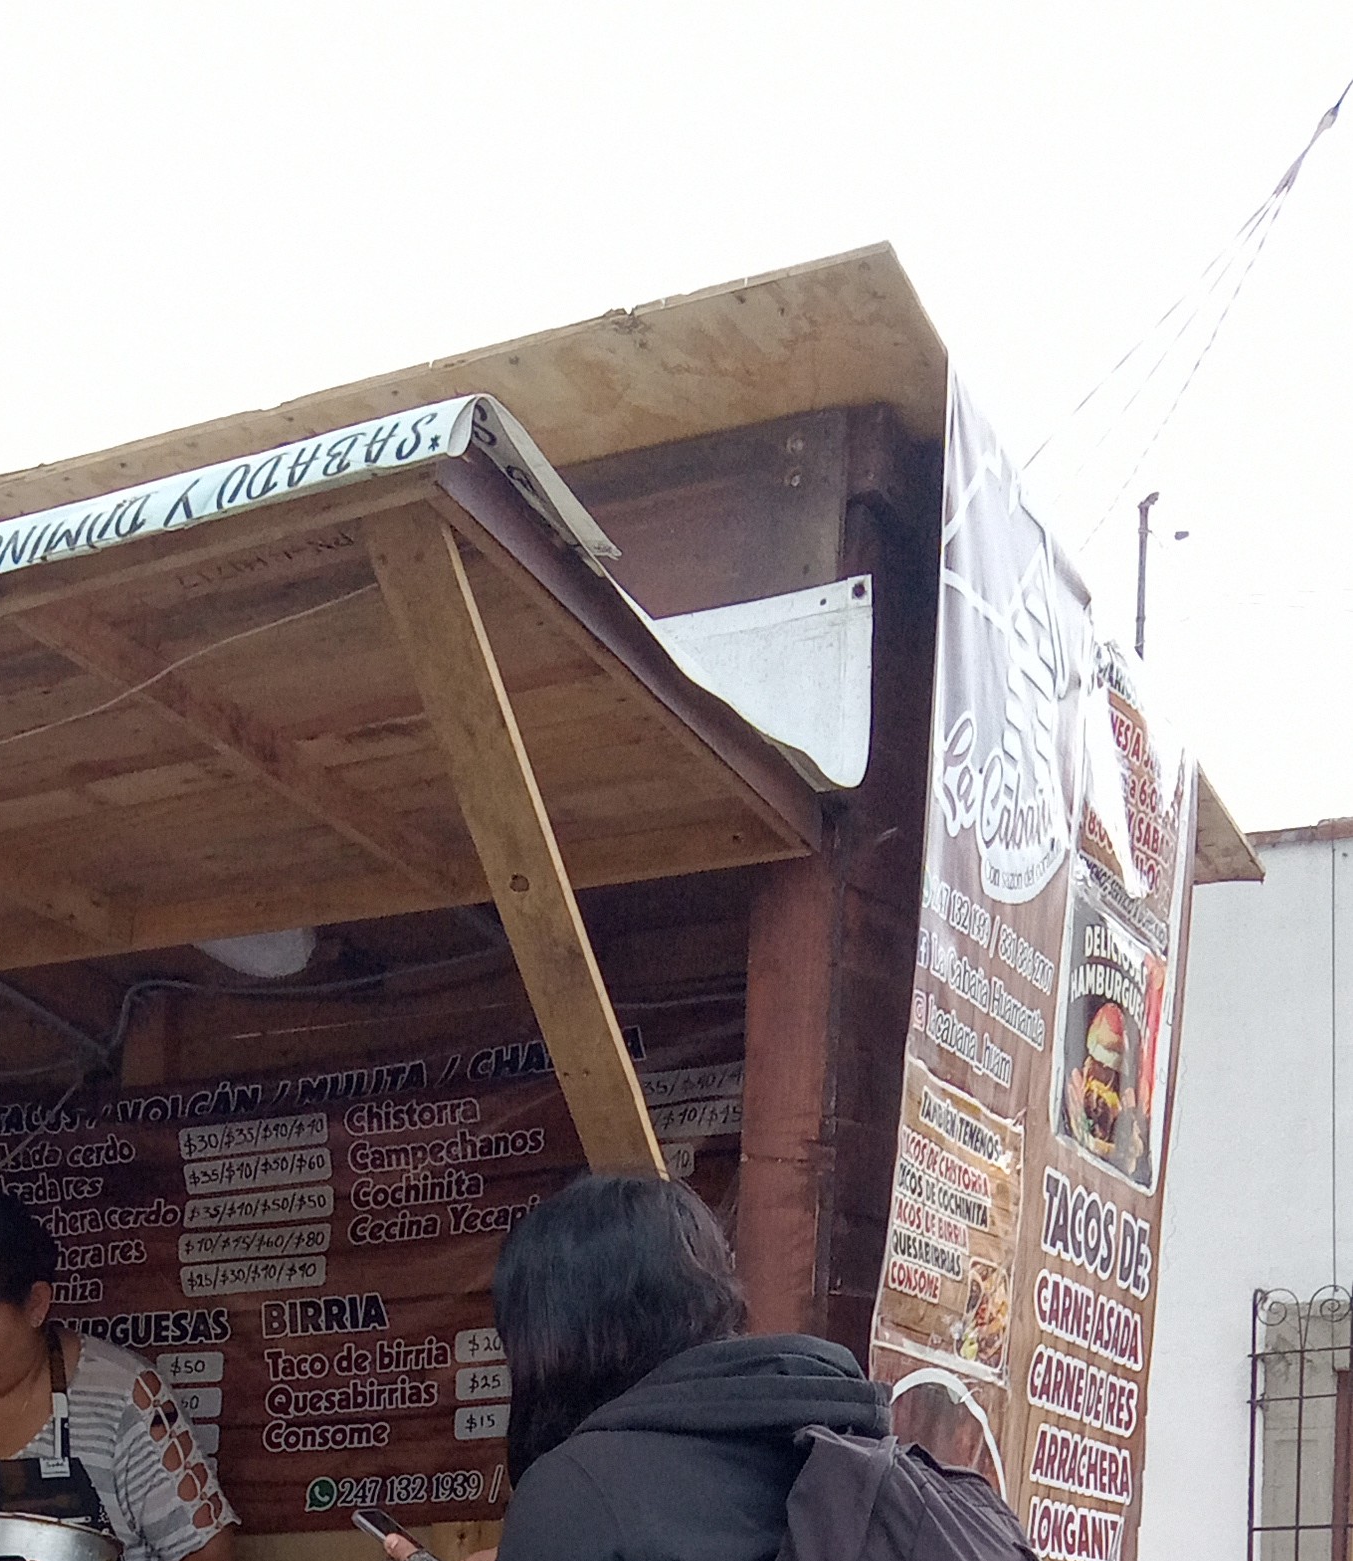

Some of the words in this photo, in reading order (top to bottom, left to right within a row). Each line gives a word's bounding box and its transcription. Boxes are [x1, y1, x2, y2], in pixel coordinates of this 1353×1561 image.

[162, 494, 199, 532] Y
[1070, 963, 1146, 1036] HAMBURGUE
[466, 1026, 645, 1082] CHAA
[344, 1097, 481, 1136] Chistorra
[66, 1133, 137, 1168] cerdo
[347, 1127, 546, 1173] Campechanos
[62, 1175, 104, 1199] res
[350, 1170, 484, 1210] Cochinita
[105, 1198, 182, 1230] cerdo
[348, 1211, 442, 1246] Cecina
[1041, 1165, 1117, 1281] TACOS
[107, 1239, 148, 1265] res
[262, 1291, 391, 1340] BIRRIA
[1034, 1268, 1095, 1349] CARNE
[1092, 1294, 1144, 1372] ASADA
[169, 1355, 206, 1377] $50
[264, 1347, 330, 1382] Taco
[334, 1342, 373, 1376] de
[376, 1335, 452, 1374] birria
[264, 1374, 439, 1418] Quesabirrias
[468, 1374, 502, 1394] $25
[1027, 1343, 1088, 1420] CARNE
[1083, 1365, 1108, 1429] DE
[1103, 1375, 1139, 1438] RES
[262, 1419, 392, 1453] Consome
[465, 1413, 496, 1434] $15
[1030, 1422, 1132, 1505] ARRACHERA
[337, 1477, 381, 1507] 247
[385, 1473, 428, 1506] 132
[431, 1469, 484, 1503] 1939
